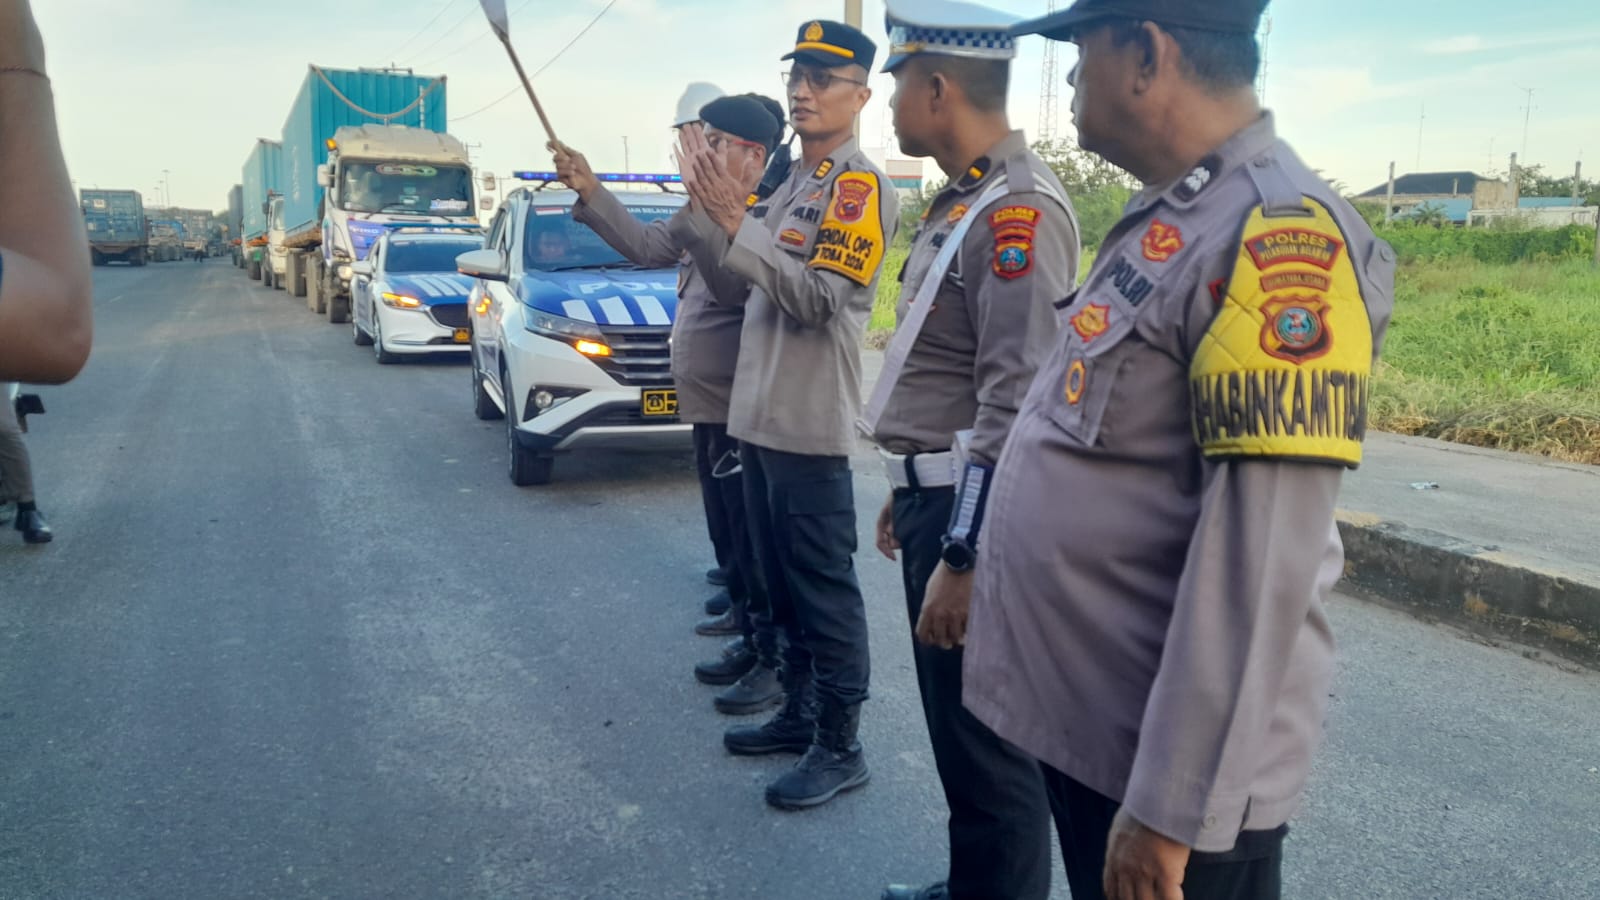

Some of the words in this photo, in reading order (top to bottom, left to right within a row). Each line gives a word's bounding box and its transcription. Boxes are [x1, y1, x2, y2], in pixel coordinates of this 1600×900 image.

[853, 236, 873, 258] OPS
[1264, 231, 1329, 249] POLRES
[1107, 256, 1154, 307] POLRI
